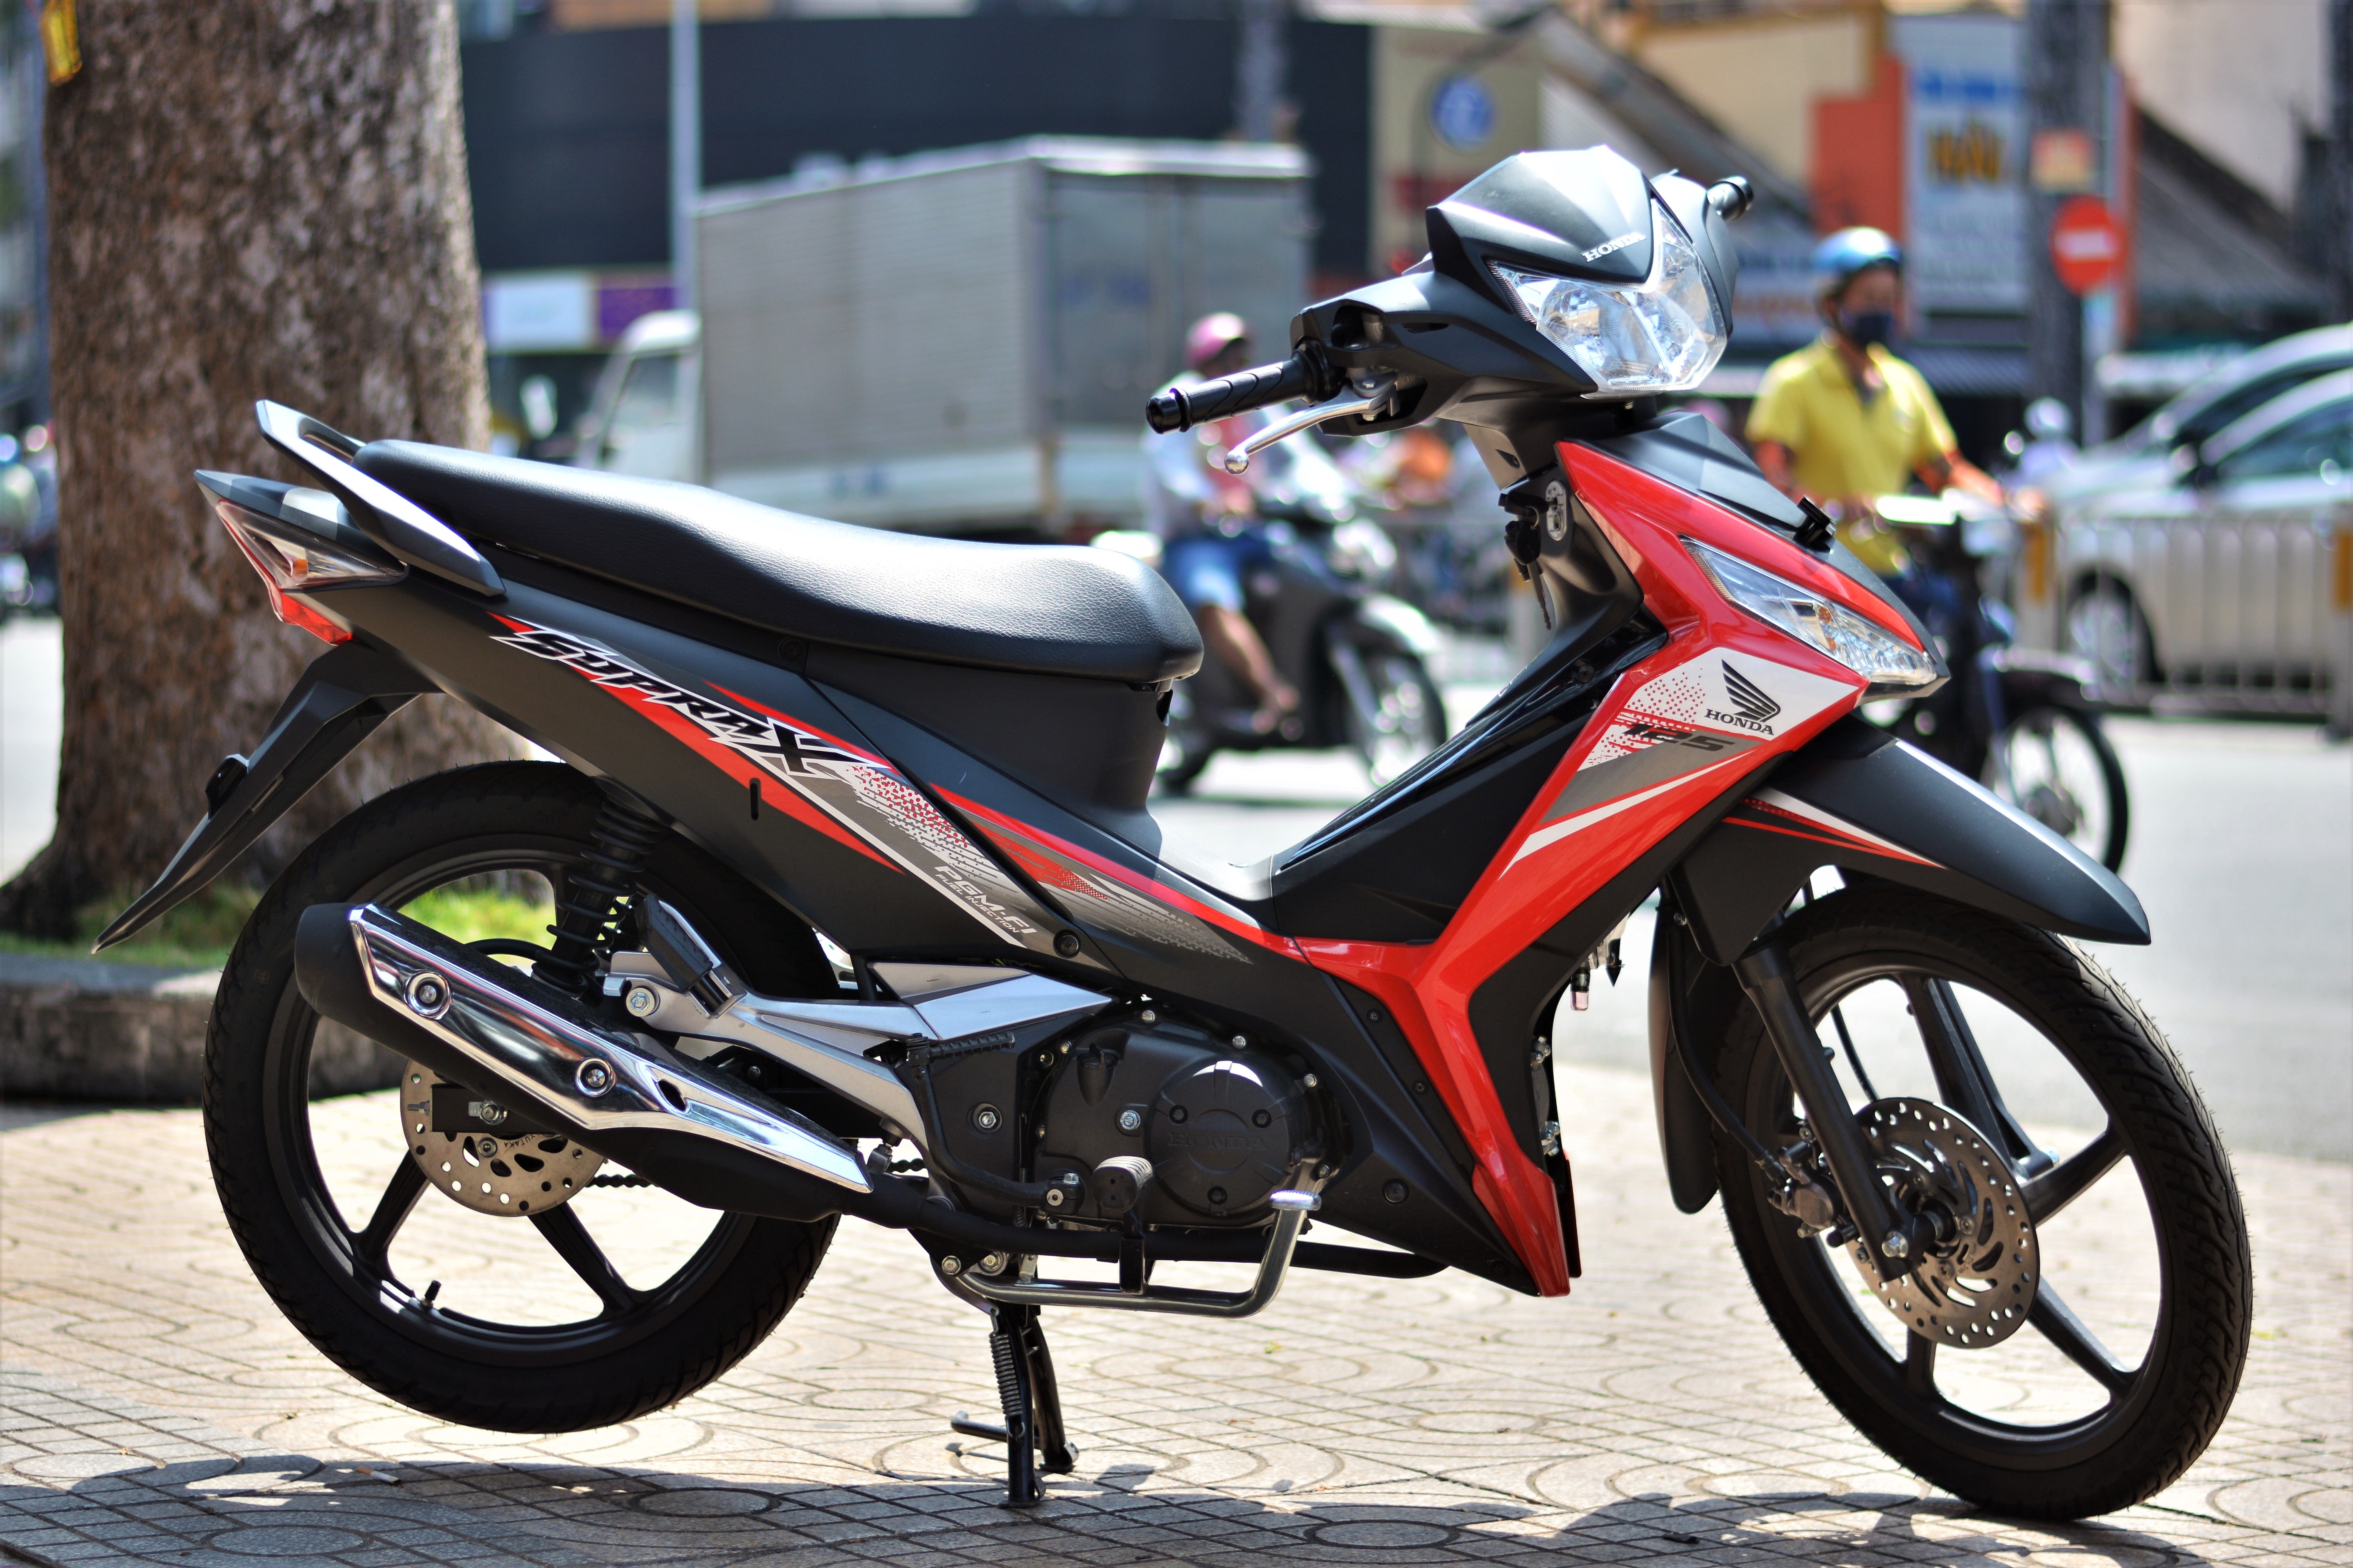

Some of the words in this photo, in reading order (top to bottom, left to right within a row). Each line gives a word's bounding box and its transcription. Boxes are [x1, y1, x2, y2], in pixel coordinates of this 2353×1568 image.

[1581, 231, 1646, 262] HONDA
[1705, 709, 1774, 736] HONDA
[1622, 723, 1735, 752] 125
[934, 866, 1037, 933] PGM-FI
[935, 874, 963, 895] FUEL
[965, 896, 1019, 933] INJECTION
[504, 1133, 536, 1148] YUTAKA
[1169, 1132, 1269, 1151] HONDA
